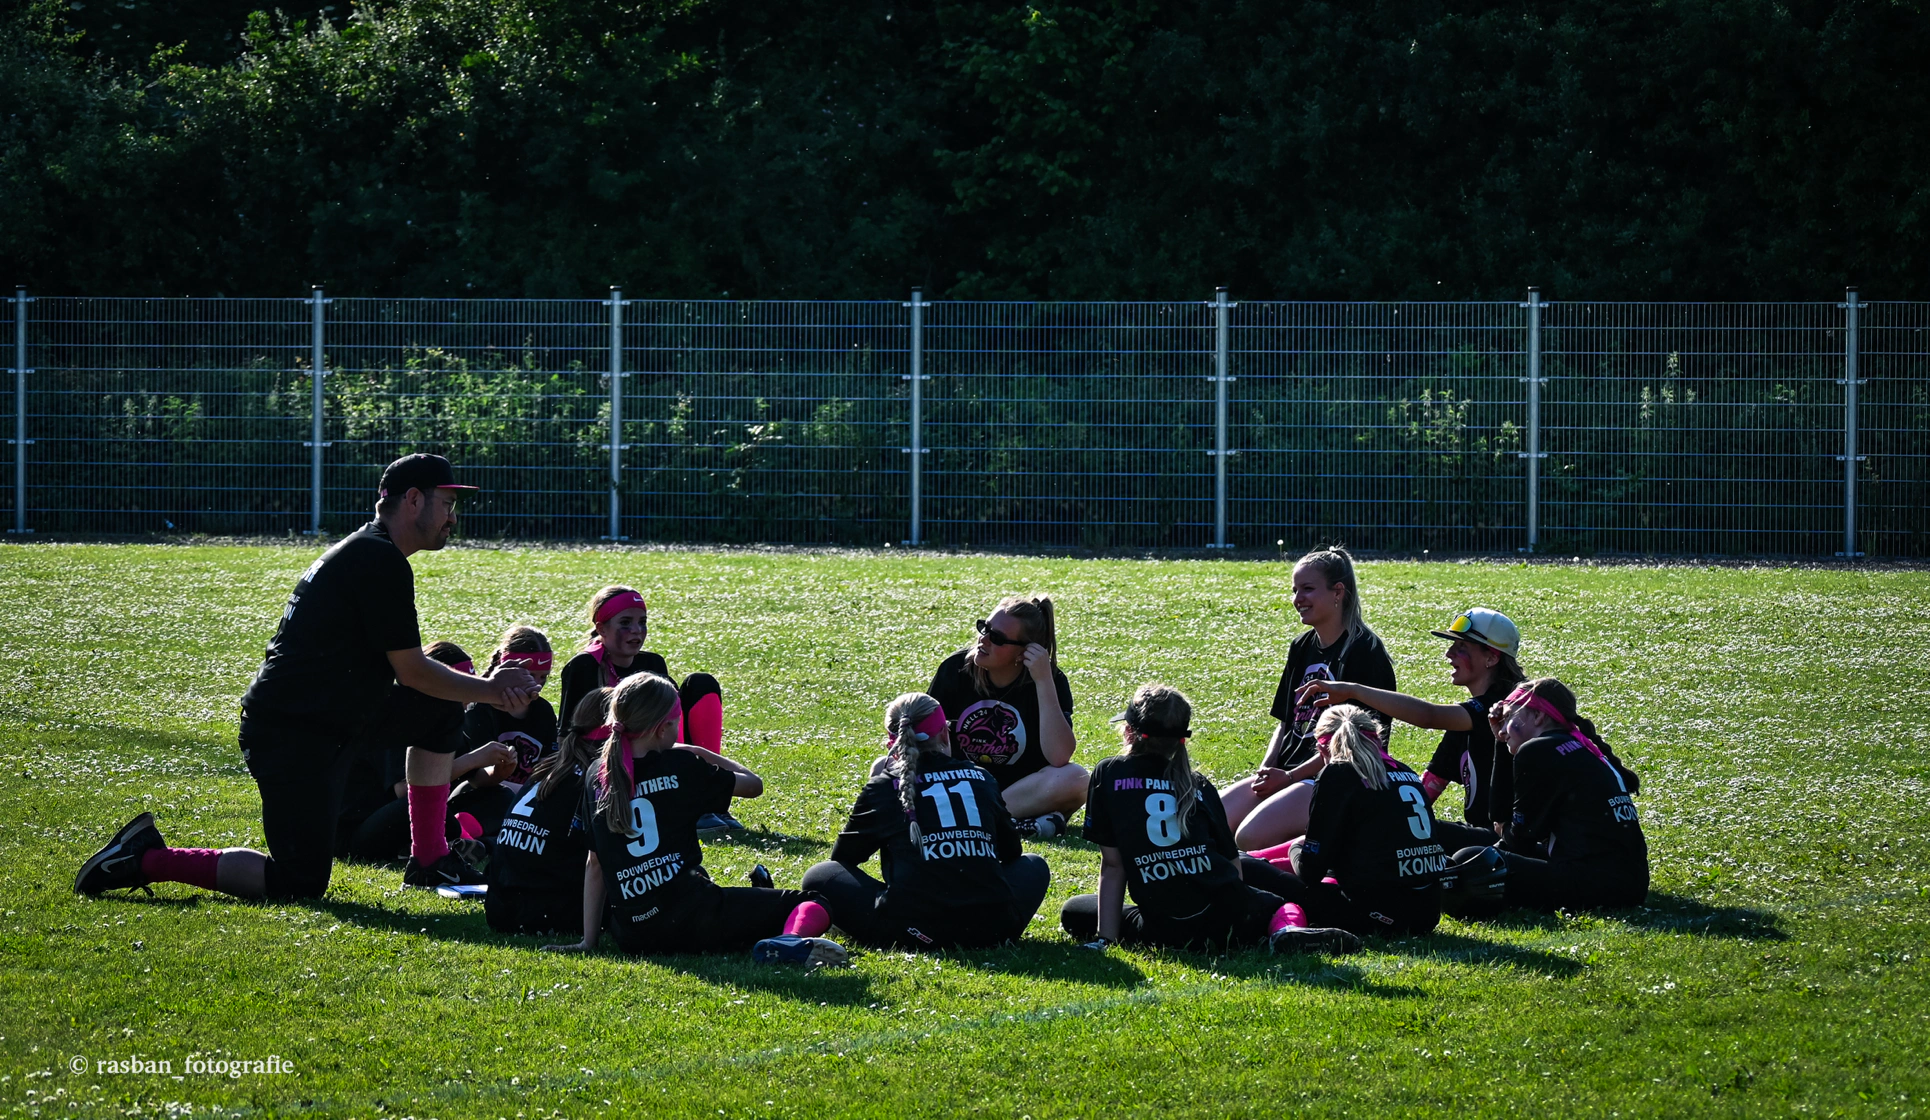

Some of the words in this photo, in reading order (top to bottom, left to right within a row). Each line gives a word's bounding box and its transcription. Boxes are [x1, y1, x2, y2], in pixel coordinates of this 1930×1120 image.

[957, 733, 1019, 755] Panthers
[633, 775, 680, 798] NTHERS
[924, 769, 986, 783] PANTHERS
[1114, 777, 1144, 791] PINK
[921, 780, 982, 828] 11
[1398, 785, 1431, 840] 3
[1613, 805, 1638, 822] KON
[625, 797, 660, 858] 9
[1145, 793, 1181, 847] 8
[497, 828, 547, 856] ONIJN
[922, 829, 993, 844] BOUWBEDRIJF
[923, 840, 997, 861] KONIJN
[1134, 844, 1207, 866] BOUWBEDRIJF
[616, 852, 682, 882] BOUWBEDRIJF
[1139, 855, 1212, 884] KONIJN
[632, 906, 660, 923] macron
